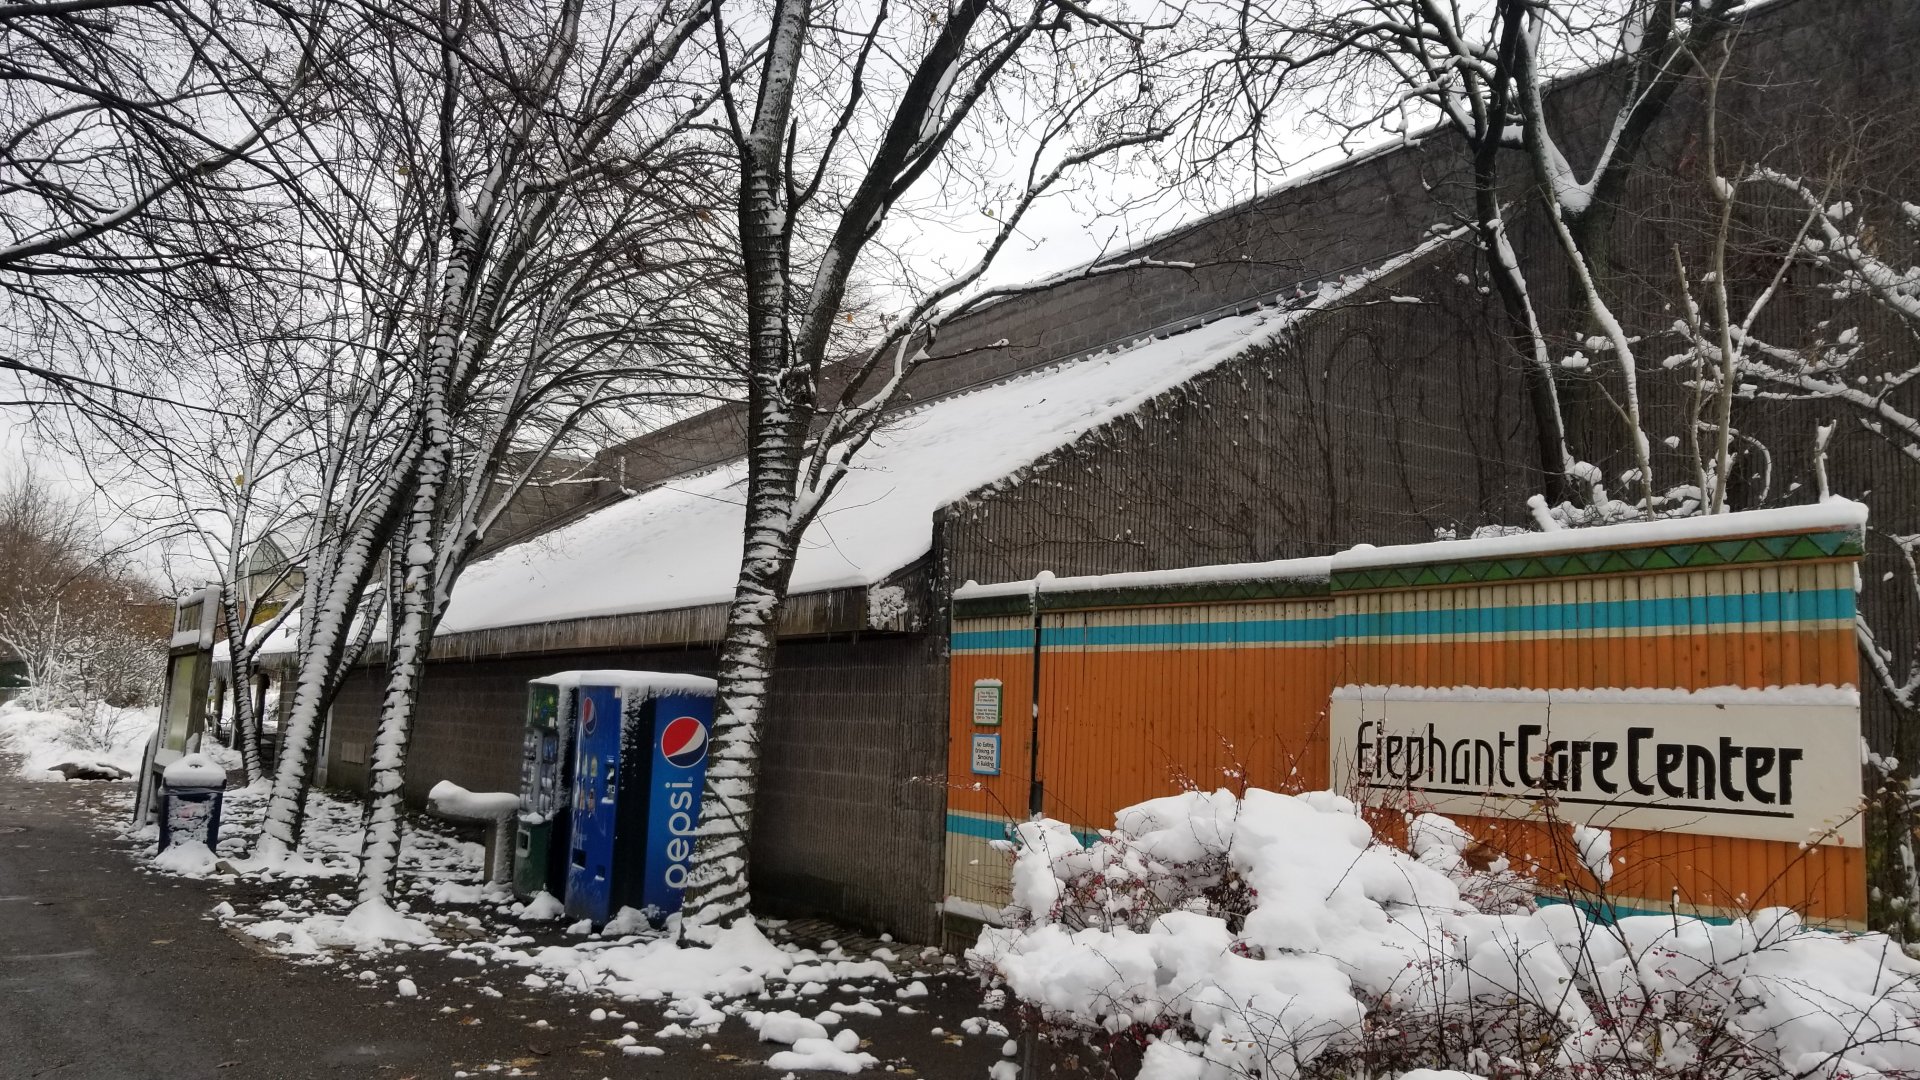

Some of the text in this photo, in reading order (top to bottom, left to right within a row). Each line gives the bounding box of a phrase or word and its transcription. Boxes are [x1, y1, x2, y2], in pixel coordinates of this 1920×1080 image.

[1357, 720, 1804, 806] Elephant Care Center
[665, 782, 698, 889] pepsi
